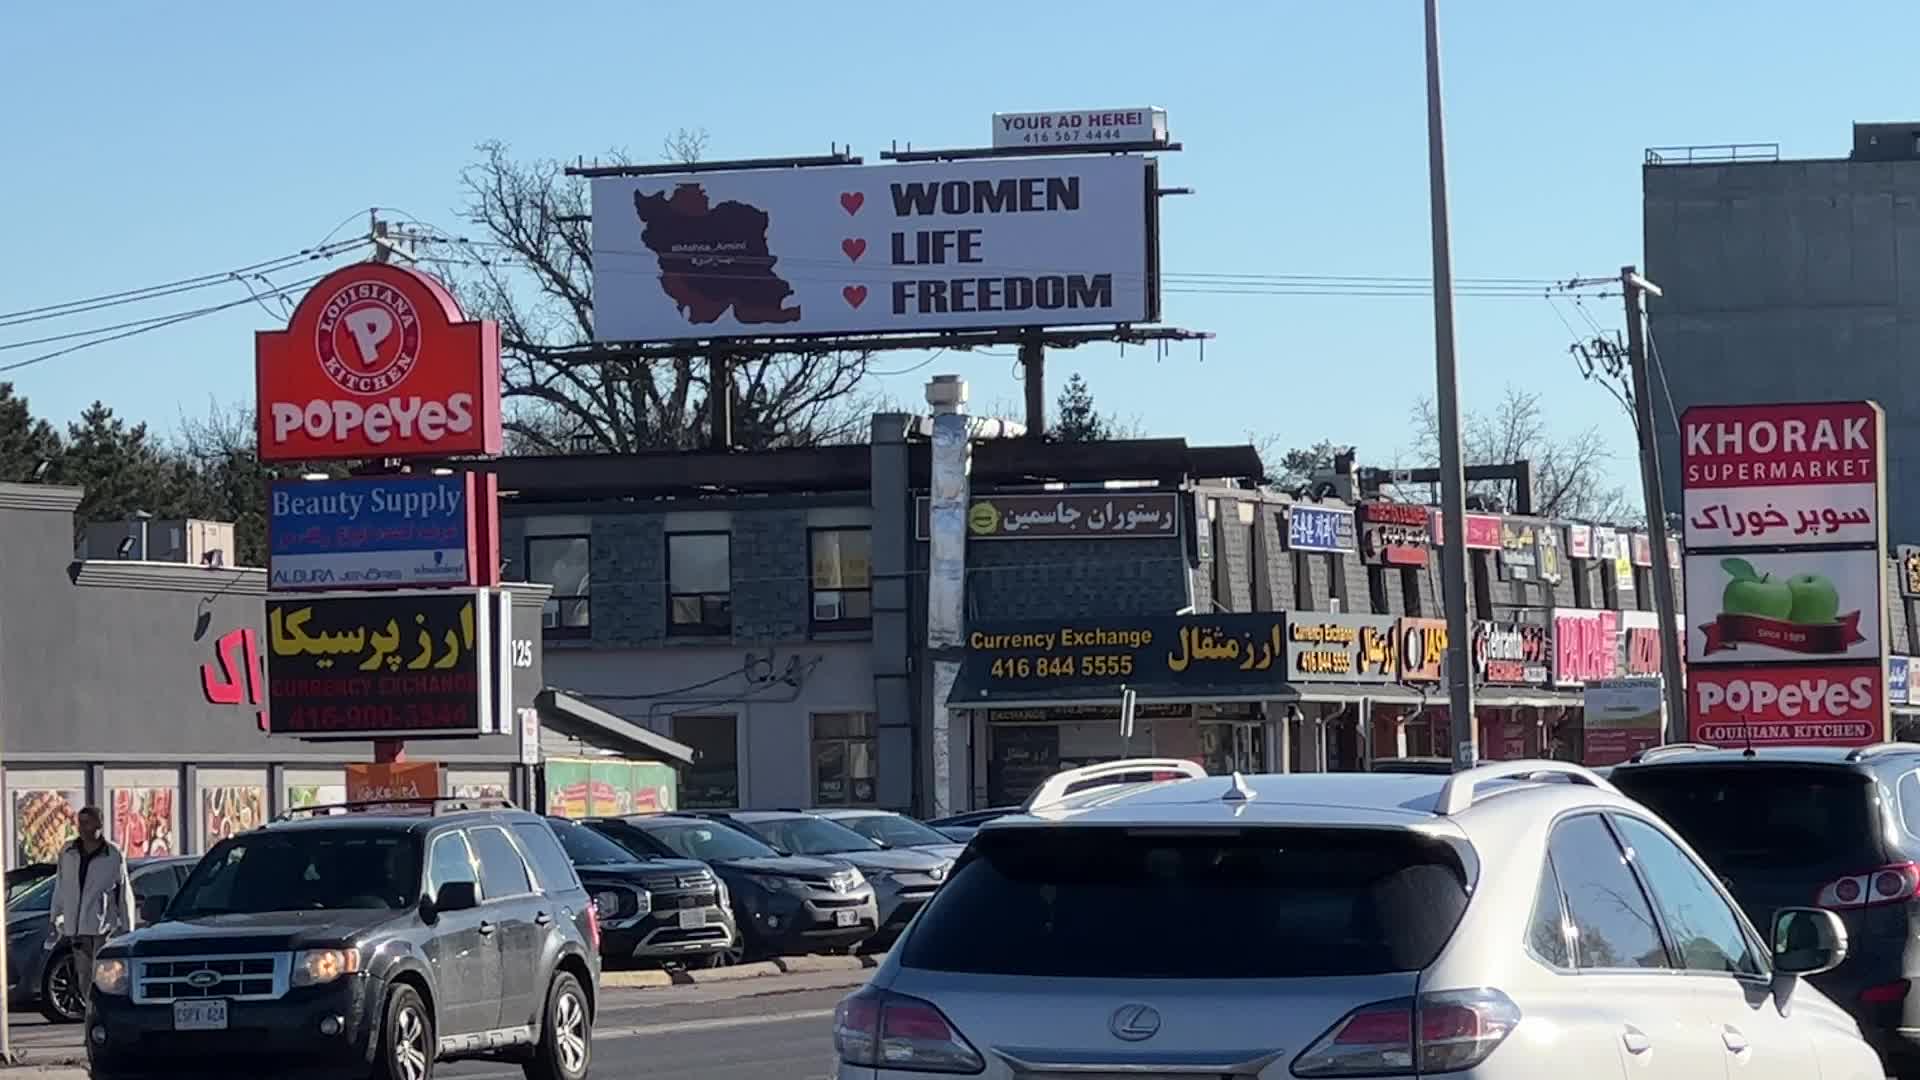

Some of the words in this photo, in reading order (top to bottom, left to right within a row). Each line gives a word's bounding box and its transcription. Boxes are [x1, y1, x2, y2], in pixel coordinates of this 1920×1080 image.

[1002, 116, 1050, 131] YOUR
[1057, 114, 1082, 129] AD
[1088, 112, 1142, 127] HERE!
[1023, 132, 1049, 144] 416
[1055, 130, 1081, 142] 567
[1086, 129, 1121, 141] 4444
[890, 176, 1080, 217] WOMEN
[891, 229, 983, 265] LIFE
[320, 284, 415, 333] LOUISIANA
[892, 273, 1112, 315] FREEDOM
[325, 352, 413, 392] KITCHEN
[1687, 417, 1870, 457] KHORAK
[1689, 458, 1871, 482] SUPERMARKET
[273, 491, 364, 521] Beauty
[371, 484, 462, 518] Supply
[1087, 500, 1173, 530] رستوران
[1690, 503, 1789, 537] خوراک
[1793, 506, 1871, 536] سوپر
[270, 606, 401, 672] پرسیکا
[408, 601, 475, 670] ارز
[511, 639, 532, 667] 125
[971, 629, 1056, 651] Currency
[1061, 627, 1152, 649] Exchange
[1167, 625, 1240, 673] مثقال
[1238, 624, 1280, 671] ارز
[991, 657, 1029, 679] 416
[1037, 656, 1075, 678] 844
[1081, 655, 1133, 677] 5555
[1793, 724, 1866, 738] KITCHEN
